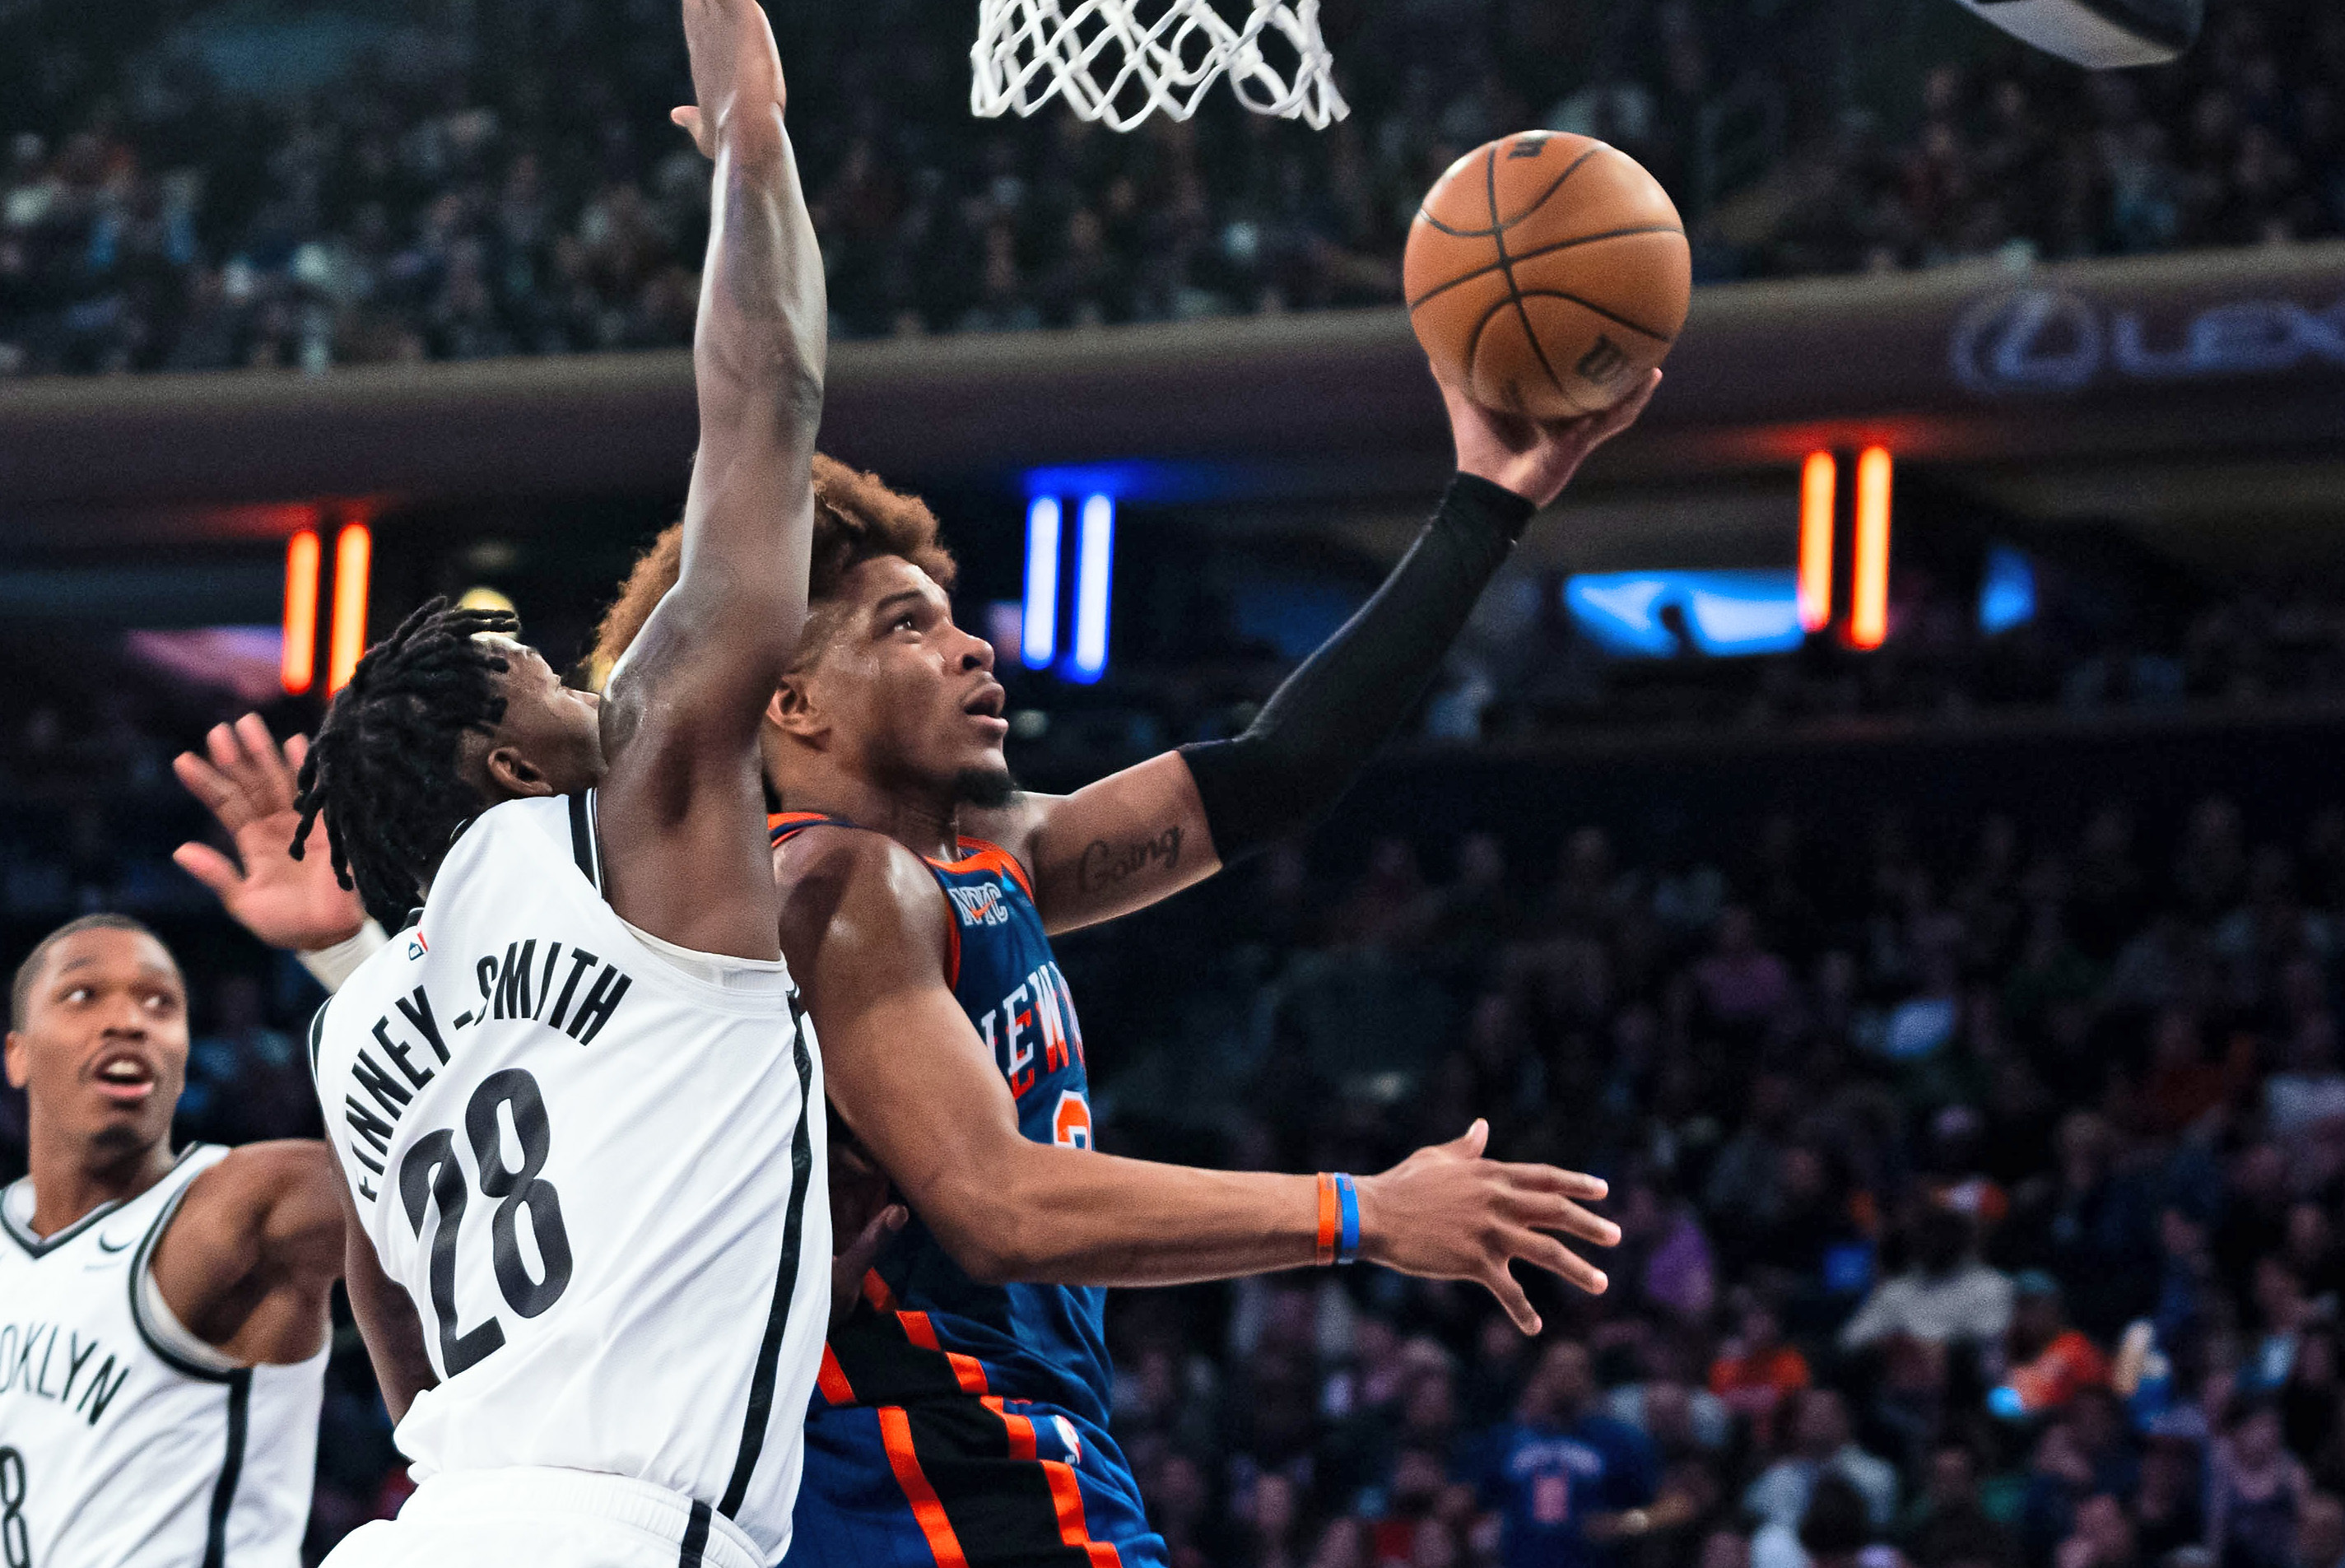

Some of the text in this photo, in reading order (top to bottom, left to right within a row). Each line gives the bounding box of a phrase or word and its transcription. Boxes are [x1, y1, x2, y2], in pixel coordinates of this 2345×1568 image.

[947, 882, 1008, 926] NYC
[345, 938, 633, 1203] FINNEY-SMITH
[398, 1068, 573, 1380] 28
